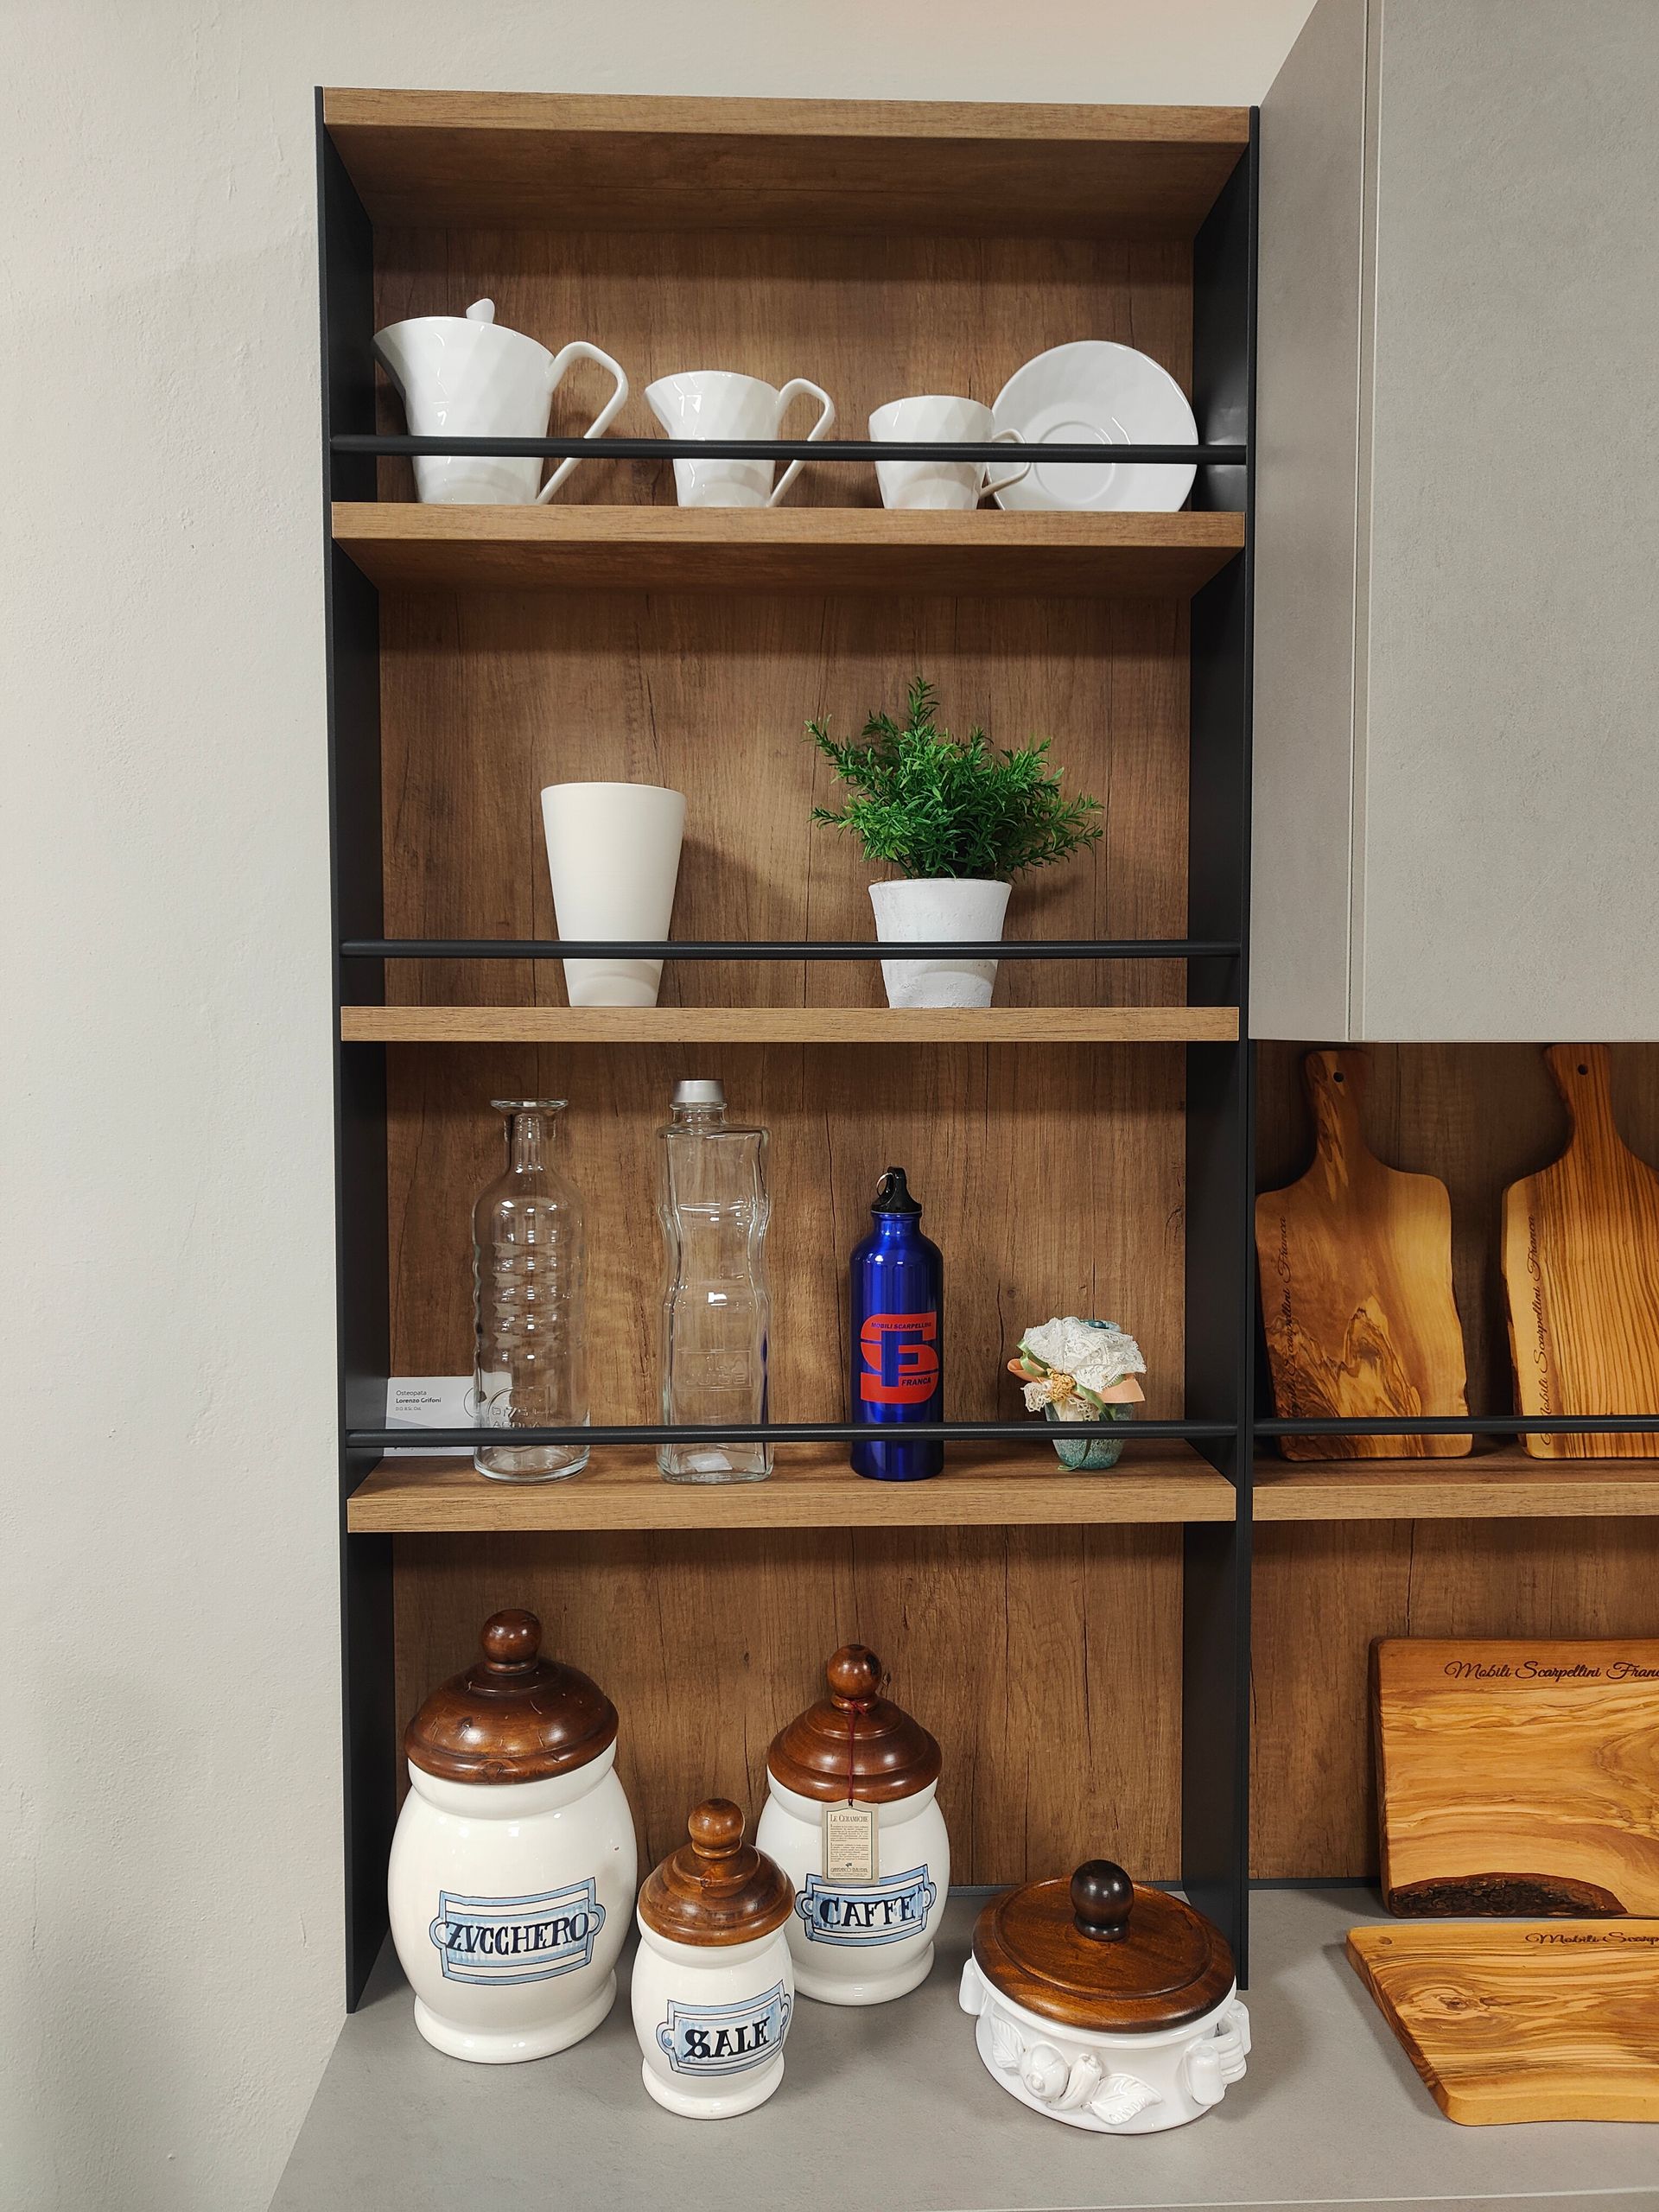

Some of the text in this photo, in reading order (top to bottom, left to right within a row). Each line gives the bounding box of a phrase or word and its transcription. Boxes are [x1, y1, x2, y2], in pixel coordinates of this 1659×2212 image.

[1277, 1216, 1292, 1284] Franca
[1527, 1213, 1541, 1282] Franca
[893, 1321, 932, 1330] SCARPELLINI
[1533, 1286, 1548, 1374] Scarpellini
[901, 1377, 931, 1387] FRANCA
[1444, 1661, 1511, 1679] Mobili
[1515, 1661, 1601, 1682] Scarpellini
[1525, 1932, 1599, 1944] Mobili
[683, 2016, 771, 2058] SALE
